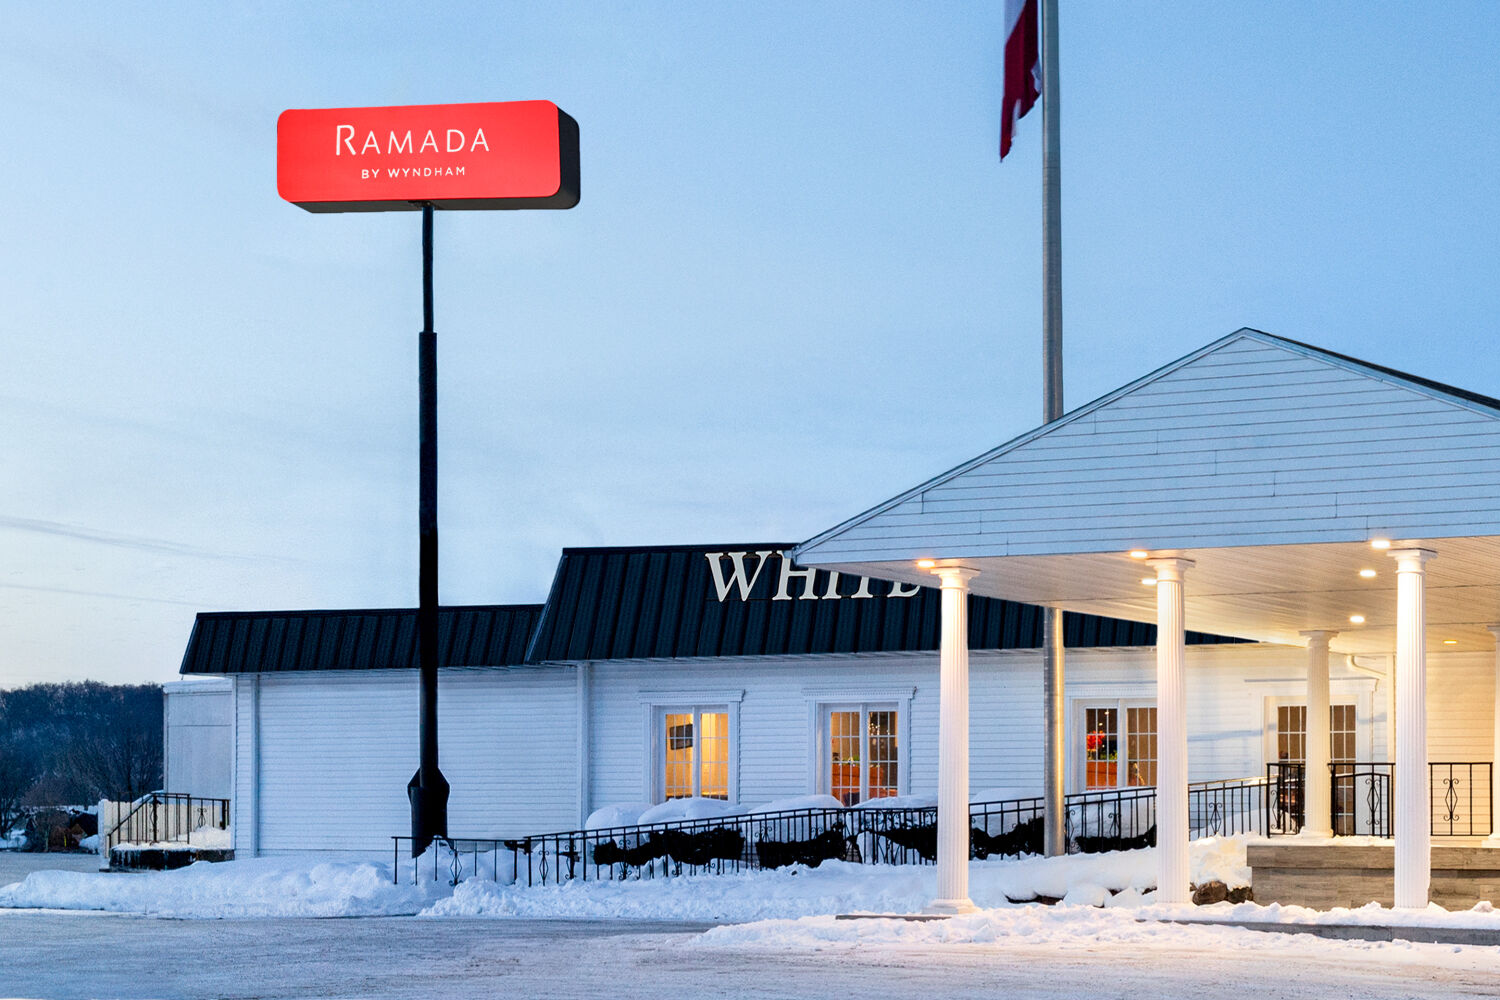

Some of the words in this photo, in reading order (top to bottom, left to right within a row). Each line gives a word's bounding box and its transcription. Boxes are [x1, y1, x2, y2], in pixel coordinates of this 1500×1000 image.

[335, 124, 490, 156] RAMADA
[361, 169, 379, 179] BY
[388, 166, 465, 178] WYNDHAM
